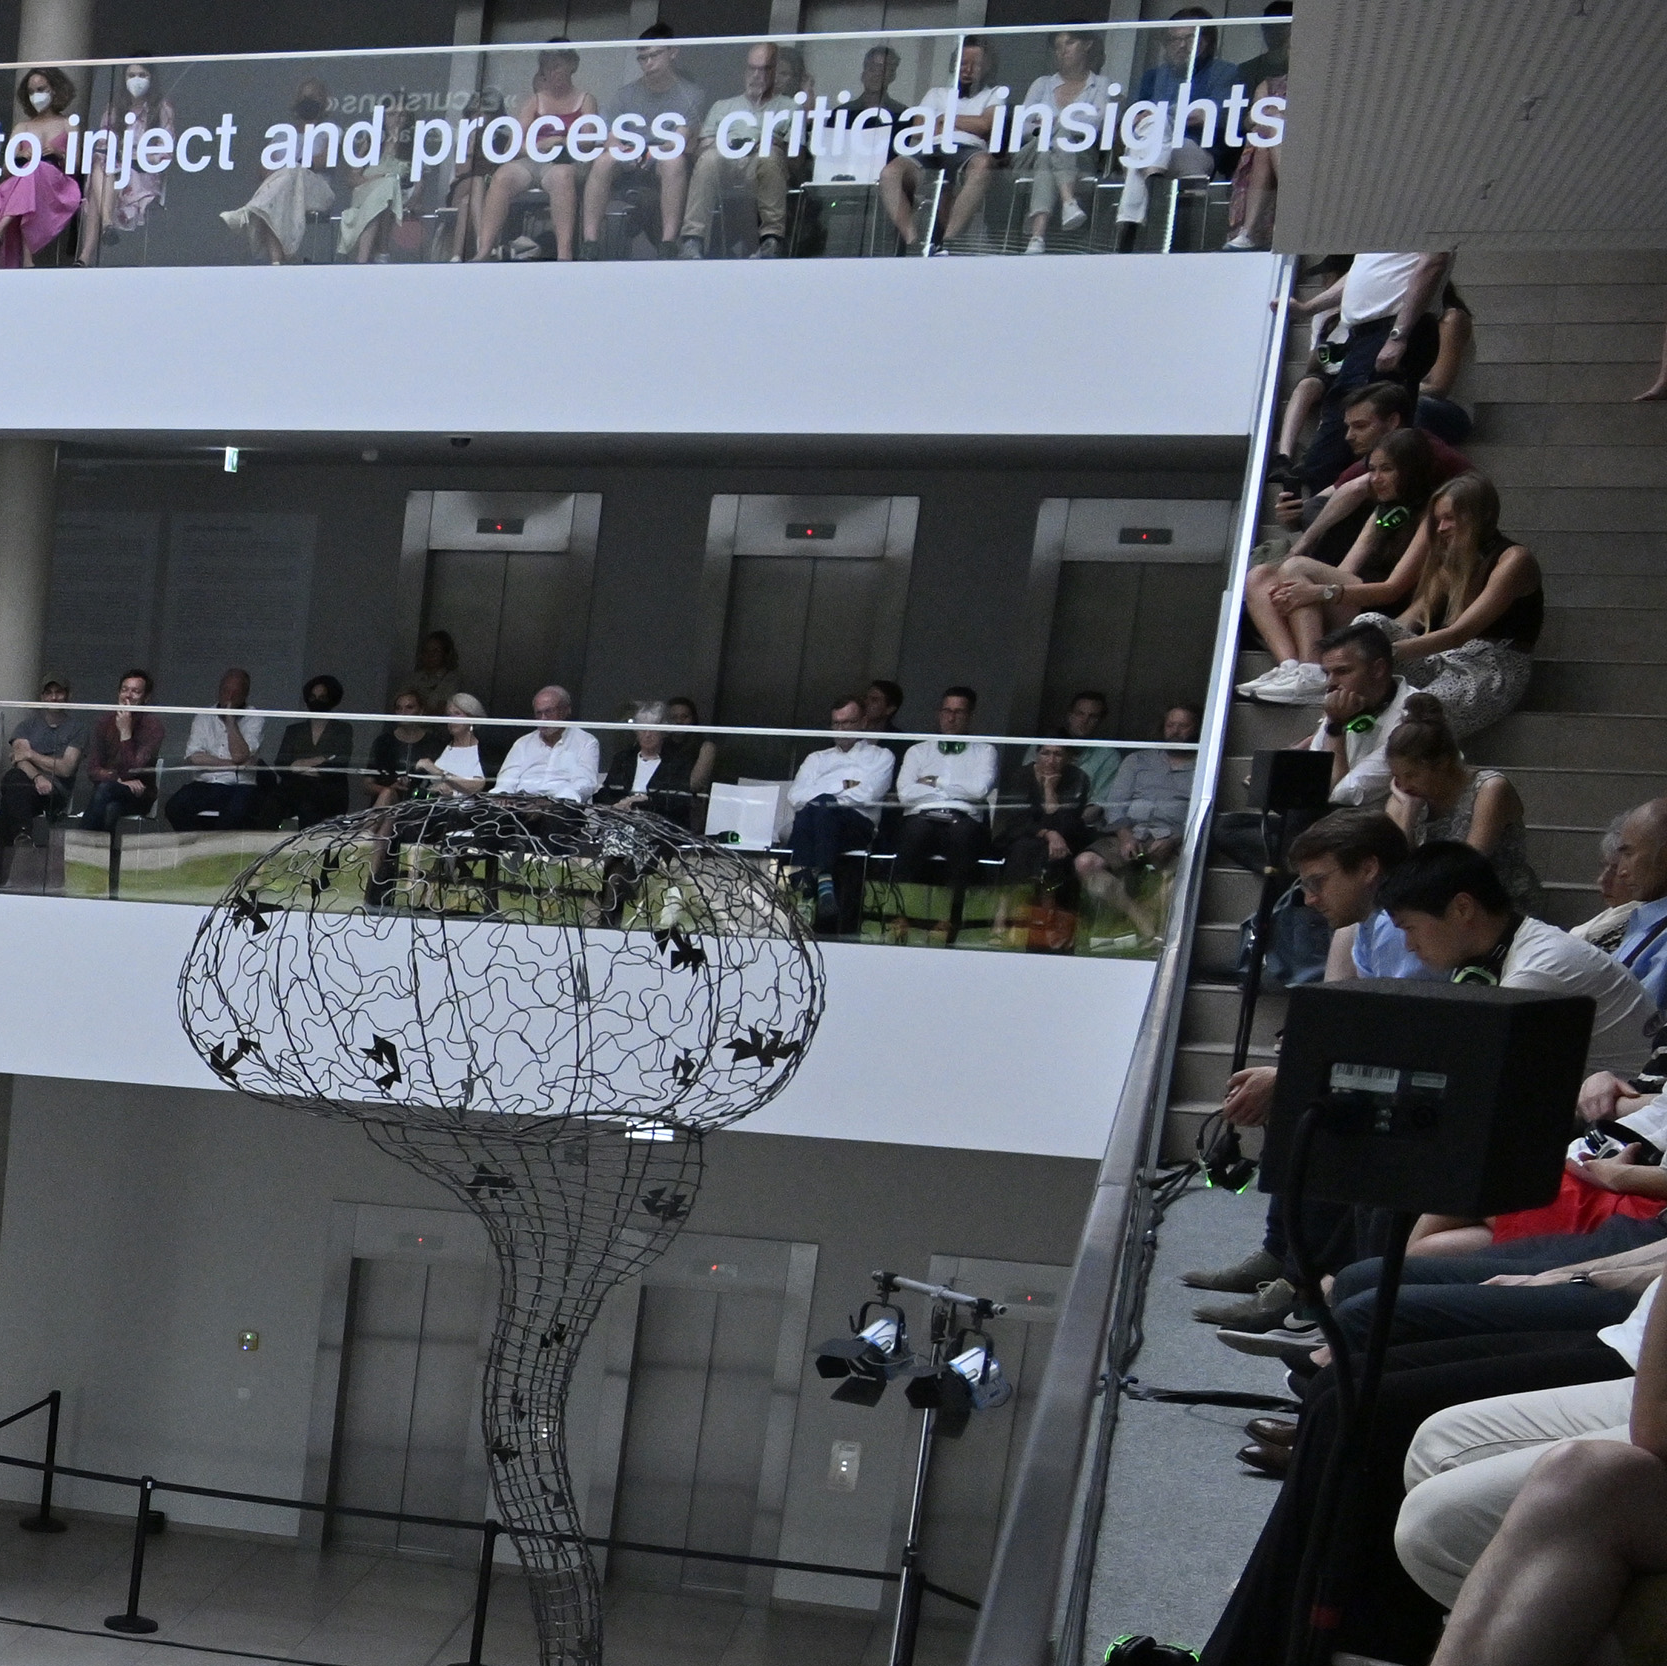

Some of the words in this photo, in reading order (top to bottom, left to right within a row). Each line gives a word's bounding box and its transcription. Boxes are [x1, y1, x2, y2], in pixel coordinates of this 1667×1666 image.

[65, 113, 237, 190] inject
[260, 105, 385, 170] and
[409, 110, 687, 182] process
[715, 83, 959, 160] critical
[988, 82, 1286, 169] insights
